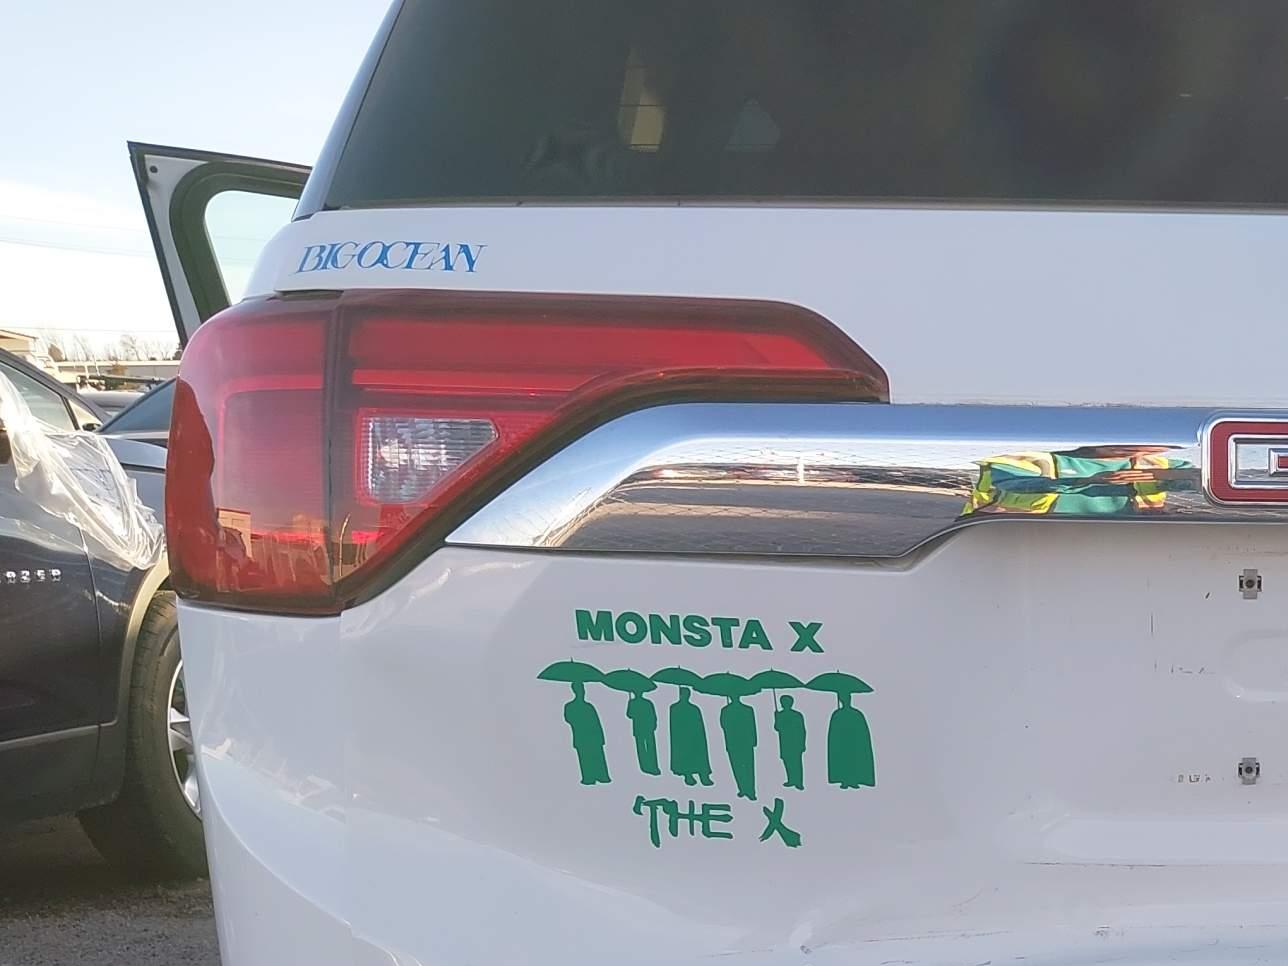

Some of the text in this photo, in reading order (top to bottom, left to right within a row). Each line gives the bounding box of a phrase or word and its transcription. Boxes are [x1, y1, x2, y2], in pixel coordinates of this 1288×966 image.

[575, 609, 825, 653] MONSTA X
[633, 795, 802, 849] THE X
